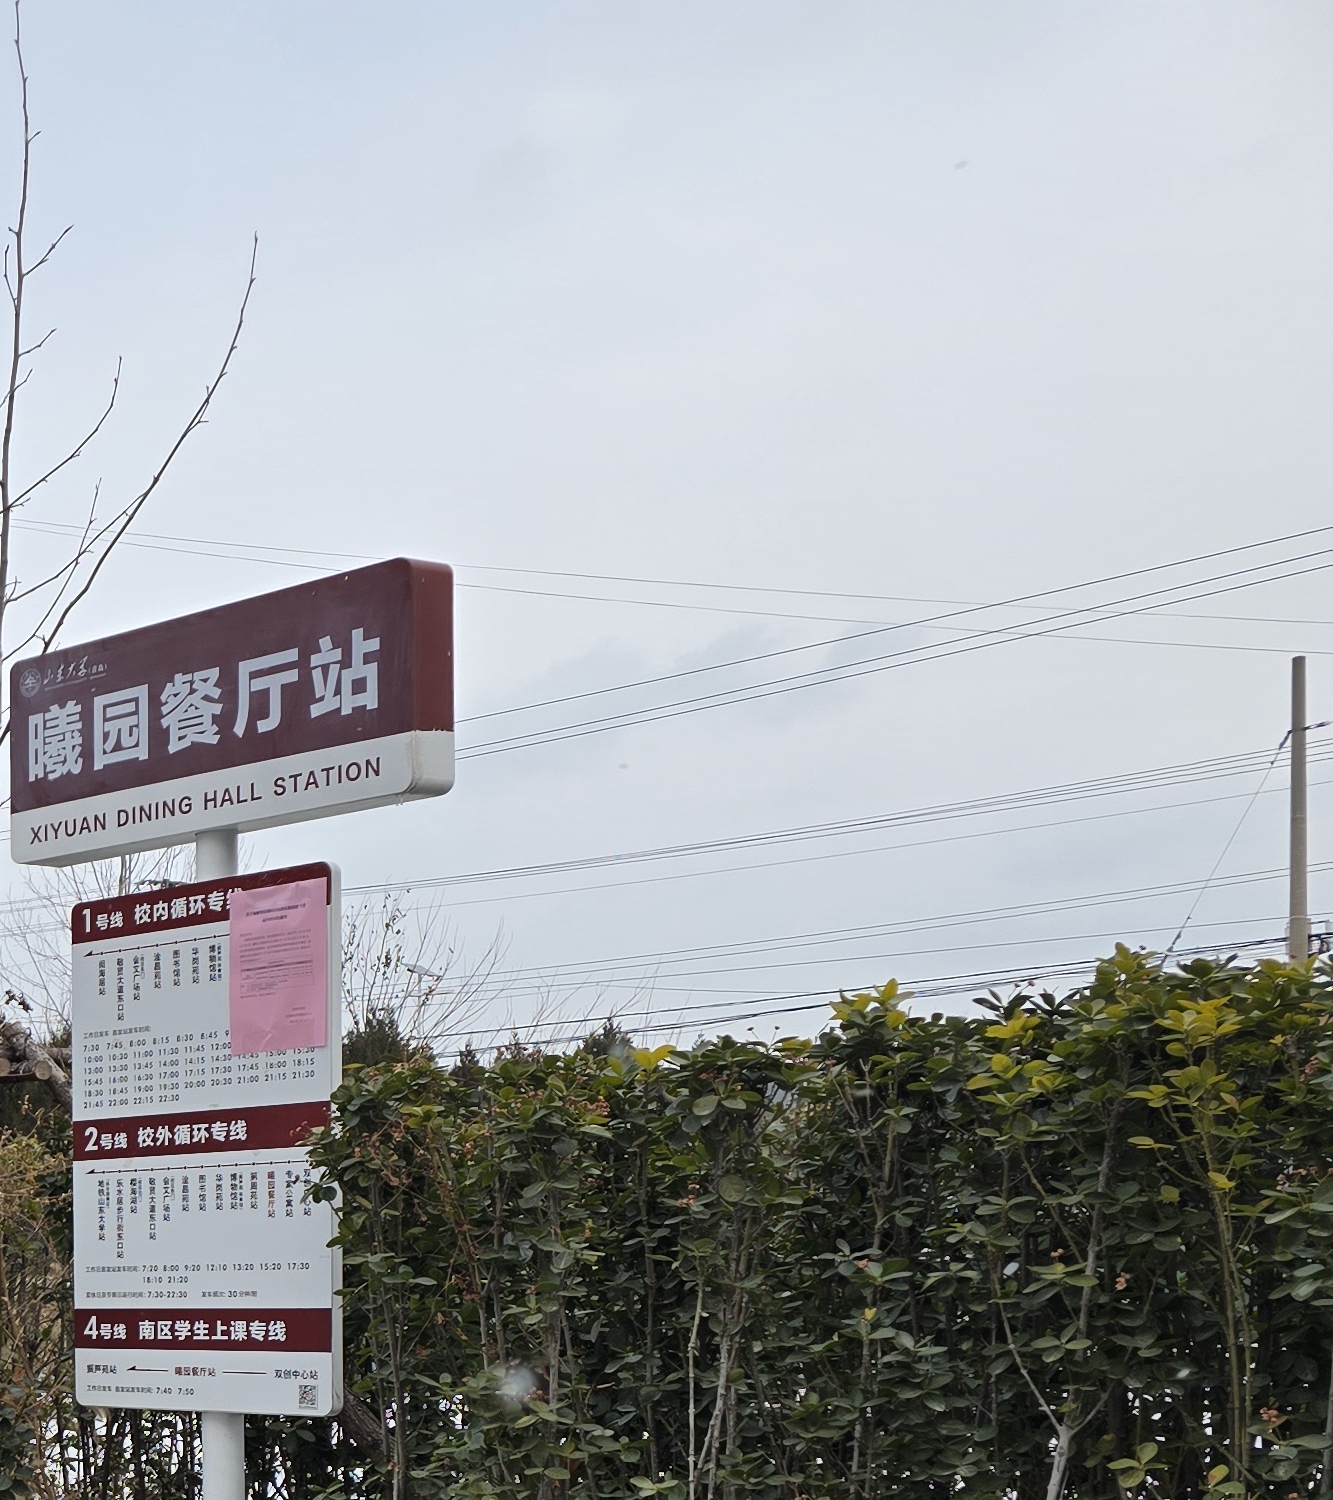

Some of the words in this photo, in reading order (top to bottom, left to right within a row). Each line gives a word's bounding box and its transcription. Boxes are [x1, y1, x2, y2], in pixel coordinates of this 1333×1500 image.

[28, 627, 380, 782] 曦园餐厅站
[30, 812, 106, 845] XIYUAN
[117, 796, 193, 828] DINING
[203, 782, 262, 811] HALL
[273, 757, 381, 796] STATION
[82, 908, 124, 933] 1号线
[83, 1044, 100, 1052] 7:30
[107, 1042, 123, 1050] 7:45
[129, 1039, 147, 1047] 8:00
[153, 1036, 170, 1045] 8:15
[177, 1034, 194, 1042] 8:30
[201, 1031, 218, 1039] 8:45
[84, 1055, 103, 1063] 10:00
[109, 1053, 128, 1061] 10:30
[133, 1050, 153, 1058] 11:00
[159, 1047, 179, 1056] 11:30
[185, 1044, 205, 1053] 11:45
[211, 1042, 232, 1050] 12:00
[84, 1067, 103, 1075] 13:00
[109, 1064, 128, 1072] 13:30
[133, 1062, 153, 1070] 13:45
[159, 1059, 179, 1067] 14:00
[185, 1056, 205, 1065] 14:15
[211, 1054, 232, 1063] 14:30
[84, 1078, 103, 1086] 15:45
[109, 1076, 128, 1084] 16:00
[133, 1073, 153, 1081] 16:30
[159, 1071, 179, 1079] 17:00
[185, 1069, 205, 1077] 17:15
[211, 1066, 232, 1074] 17:30
[237, 1063, 259, 1072] 17:45
[292, 1058, 315, 1066] 18:15
[84, 1090, 103, 1098] 18:30
[109, 1087, 128, 1095] 18:45
[133, 1085, 153, 1093] 19:00
[159, 1082, 179, 1091] 19:30
[184, 1080, 205, 1089] 20:00
[211, 1078, 232, 1086] 20:30
[237, 1075, 259, 1084] 21:00
[265, 1073, 287, 1082] 21:15
[292, 1070, 315, 1079] 21:30
[83, 1101, 103, 1109] 21:45
[108, 1098, 129, 1107] 22:00
[133, 1096, 153, 1105] 22:15
[159, 1094, 180, 1102] 22:30
[84, 1127, 128, 1152] 2号线
[137, 1120, 247, 1147] 校外循环专线
[163, 1264, 179, 1272] 8:00
[184, 1264, 201, 1272] 9:20
[232, 1263, 254, 1271] 13:20
[287, 1262, 310, 1270] 17:30
[143, 1276, 163, 1284] 18:10
[167, 1276, 189, 1284] 21:20
[227, 1290, 237, 1298] 30
[83, 1316, 126, 1340] 4号线
[138, 1320, 286, 1341] 南区学生上课专线
[274, 1369, 318, 1380] 双创中心站
